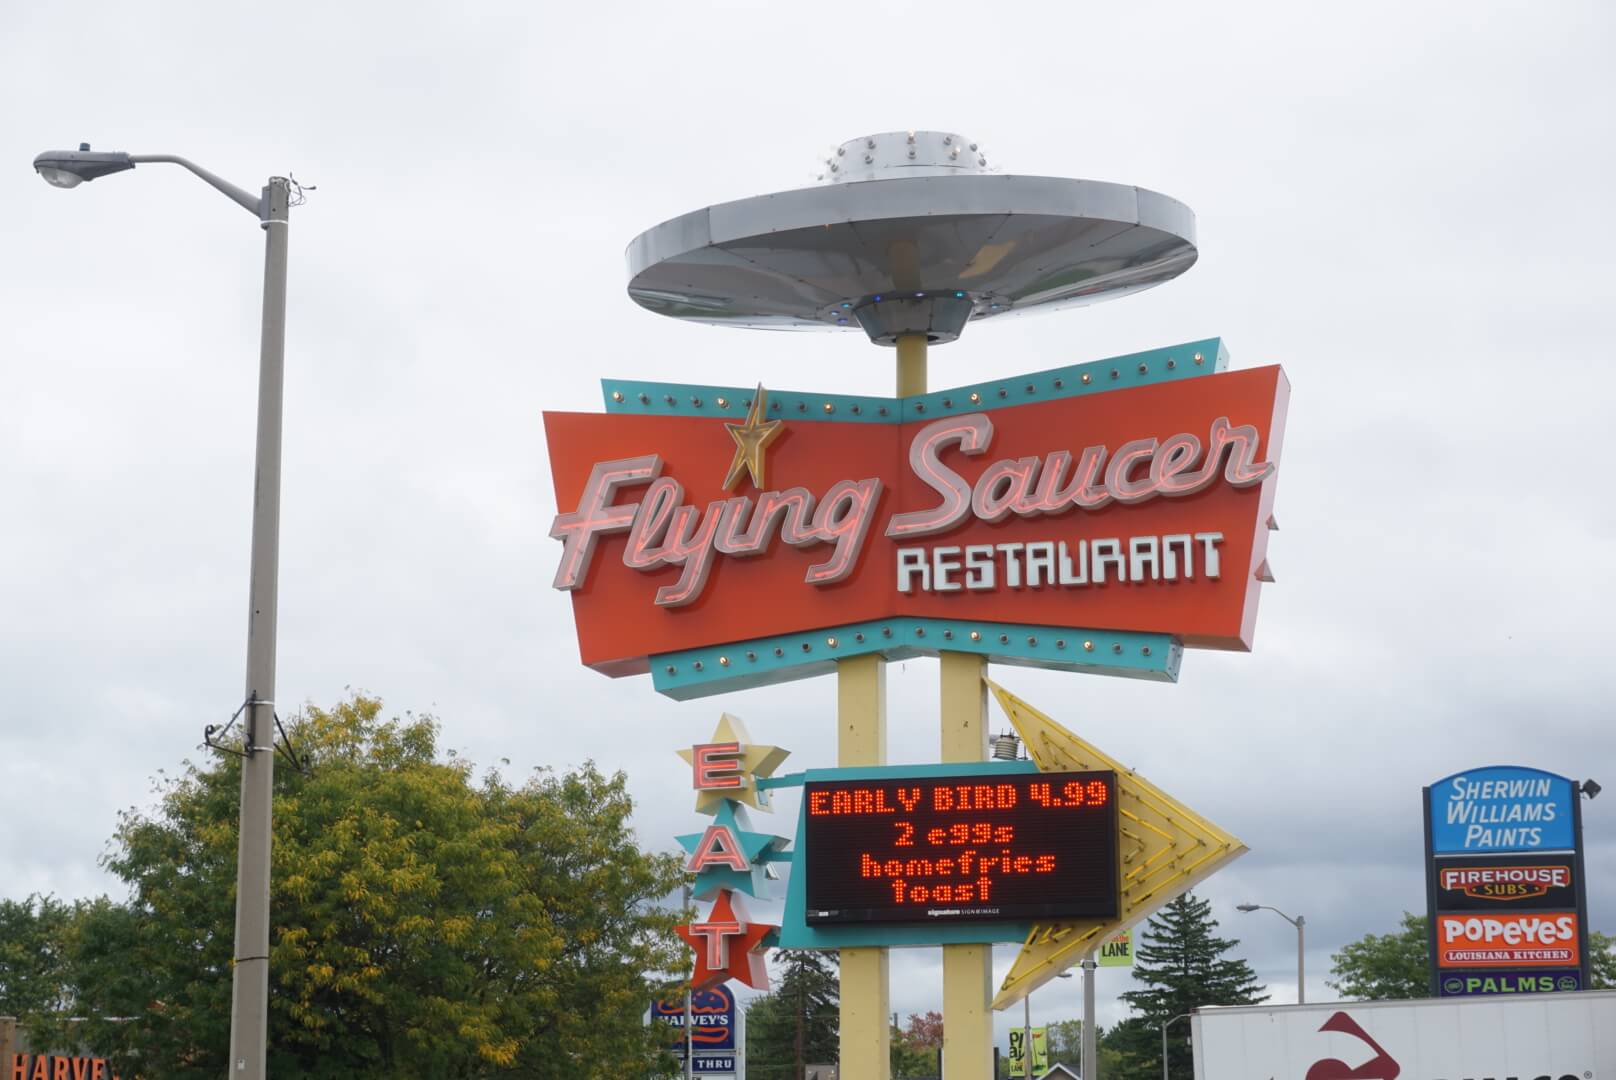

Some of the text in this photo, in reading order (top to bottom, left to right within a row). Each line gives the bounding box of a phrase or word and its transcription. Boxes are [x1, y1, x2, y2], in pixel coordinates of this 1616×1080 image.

[549, 413, 1276, 606] Flying Saucer
[897, 532, 1224, 593] RESTAURANT
[811, 781, 1107, 815] EARLY BIRD 4.99
[1450, 777, 1552, 800] SHERWIN
[1447, 801, 1557, 824] WILLIAMS
[895, 821, 1013, 846] 2 eggs
[1464, 825, 1542, 848] PAINTS
[861, 849, 1056, 877] homefries
[892, 876, 992, 903] toast
[1446, 869, 1566, 890] FIREHOUSE
[1484, 884, 1527, 895] SUBS
[1102, 942, 1129, 957] LANE
[1449, 950, 1568, 961] LOUISIANA KITCHEN
[1466, 977, 1554, 993] PALMS
[12, 1054, 120, 1080] HARVE
[697, 1060, 732, 1069] THRU
